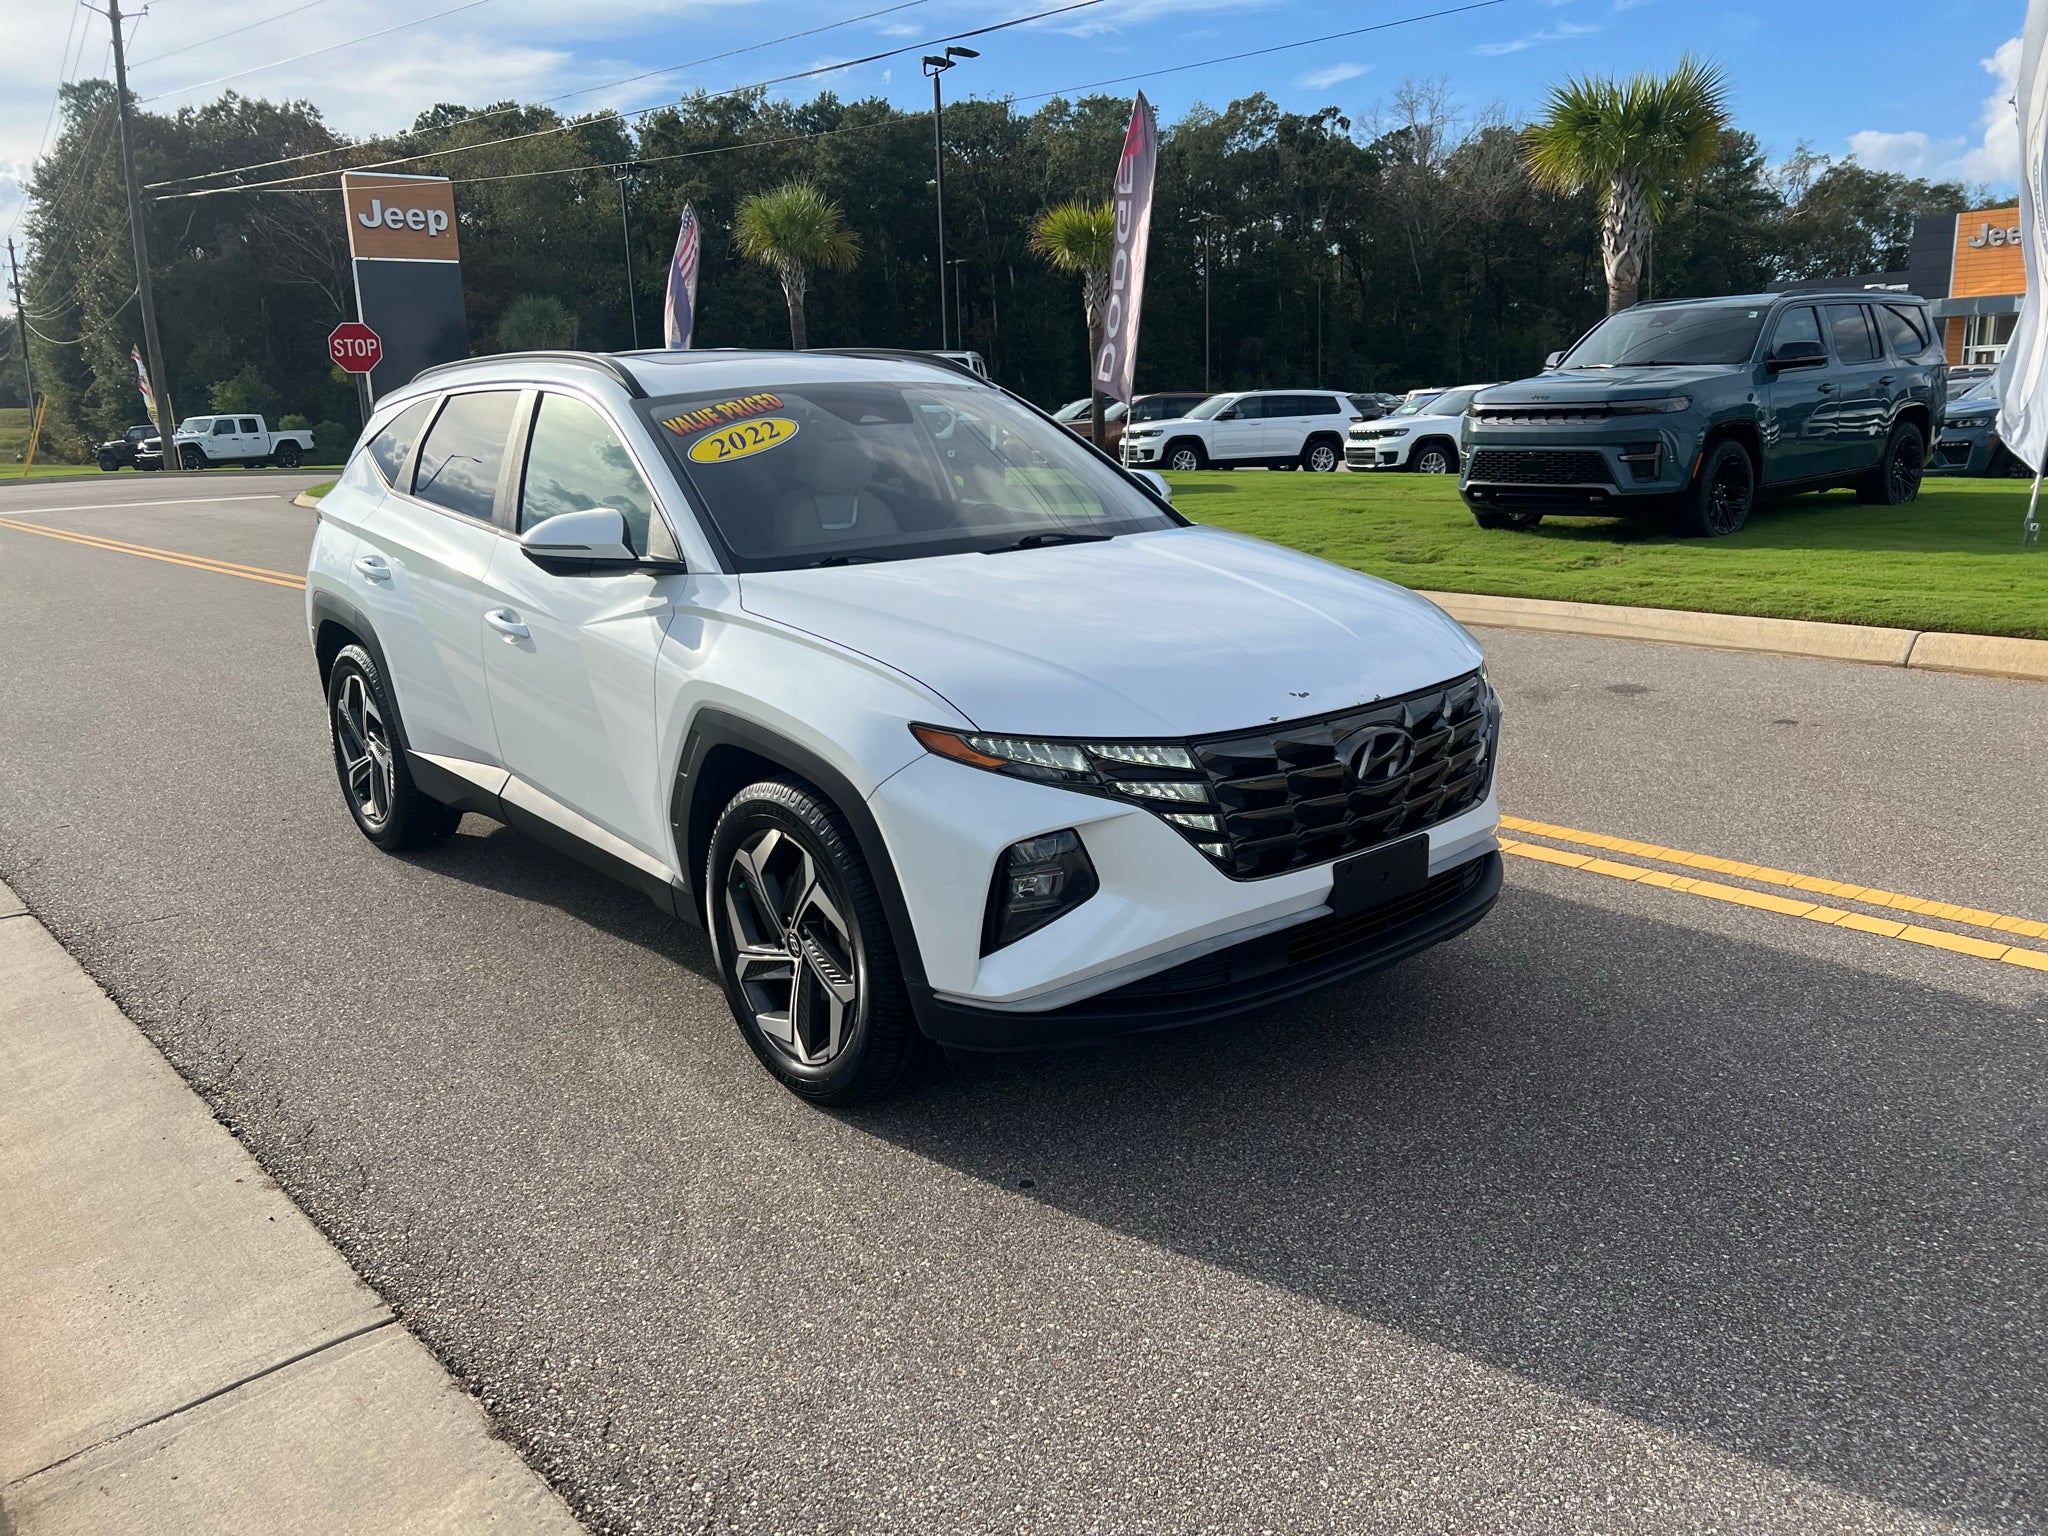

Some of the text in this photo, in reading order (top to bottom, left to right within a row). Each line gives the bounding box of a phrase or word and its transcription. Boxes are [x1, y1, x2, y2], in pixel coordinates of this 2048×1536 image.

[358, 199, 448, 237] Jeep
[1968, 223, 2022, 248] Jee
[1097, 155, 1133, 382] DODGE
[333, 338, 377, 357] STOP
[662, 393, 784, 436] VALUE PRICED
[711, 421, 781, 458] 2022
